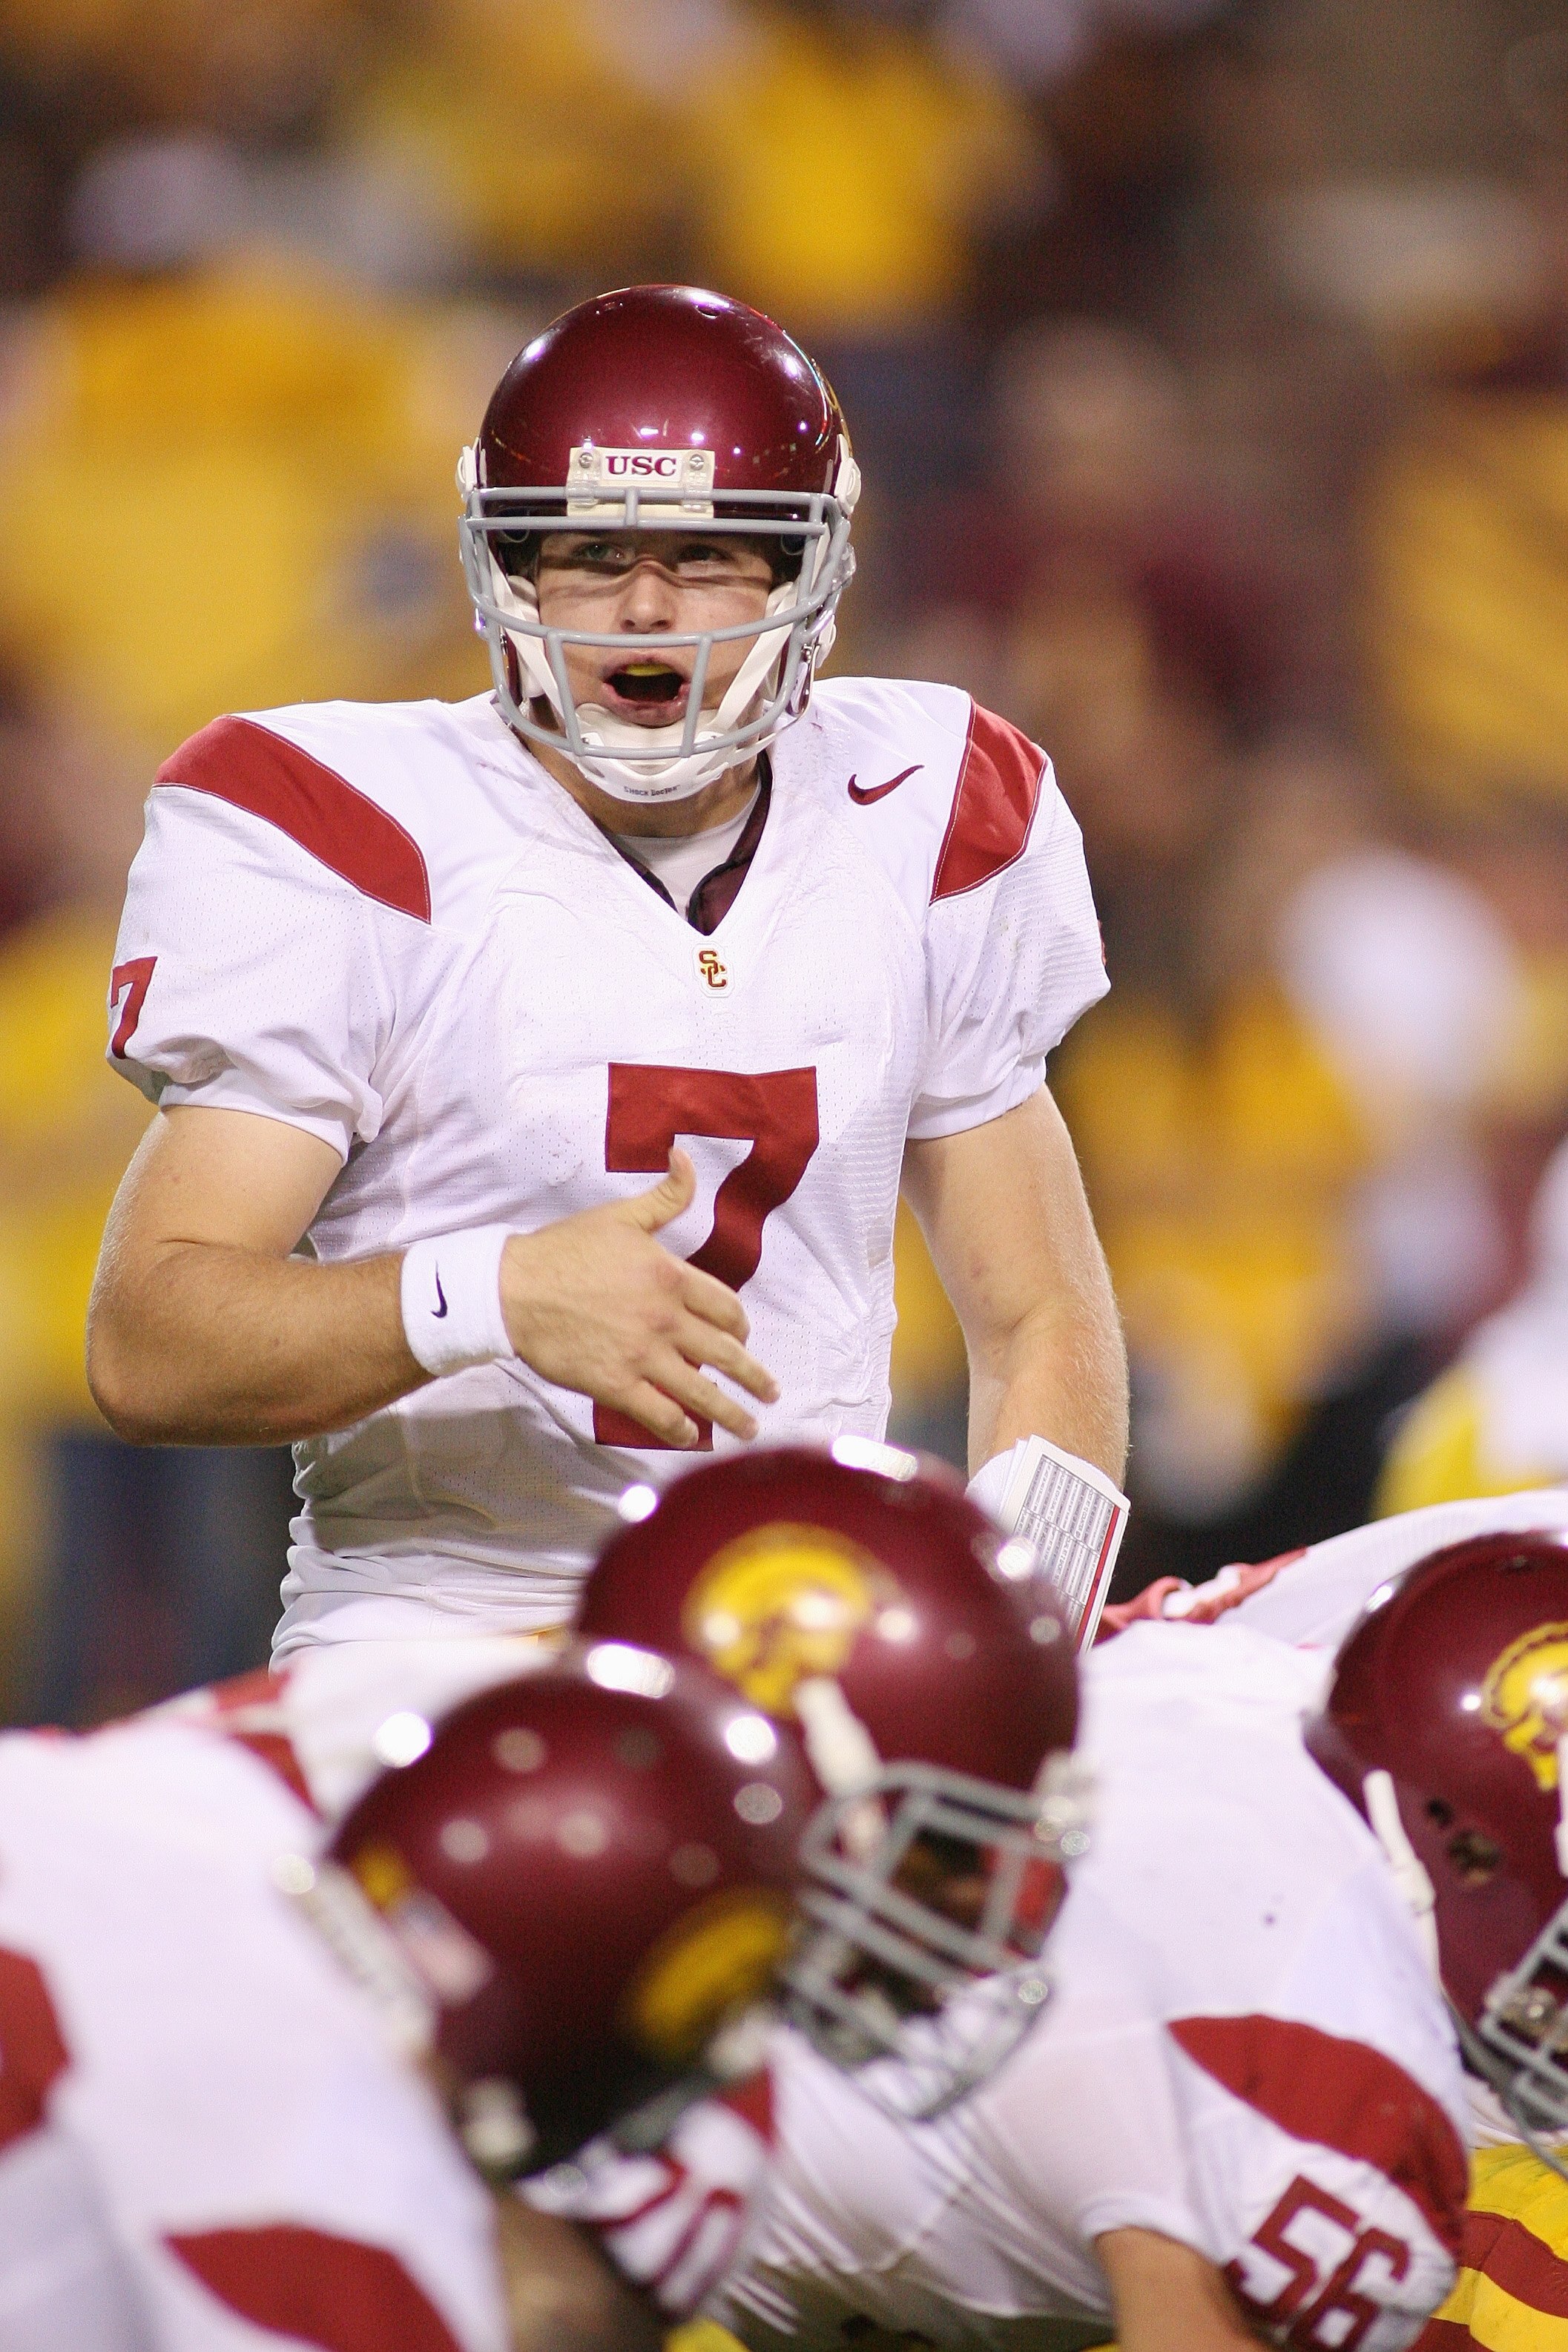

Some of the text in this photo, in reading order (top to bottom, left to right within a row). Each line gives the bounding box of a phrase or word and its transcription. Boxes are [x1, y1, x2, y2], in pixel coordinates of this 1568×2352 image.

[605, 455, 677, 476] USC
[111, 956, 158, 1060] 7
[593, 1062, 820, 1452] 7
[1222, 2174, 1412, 2352] 56
